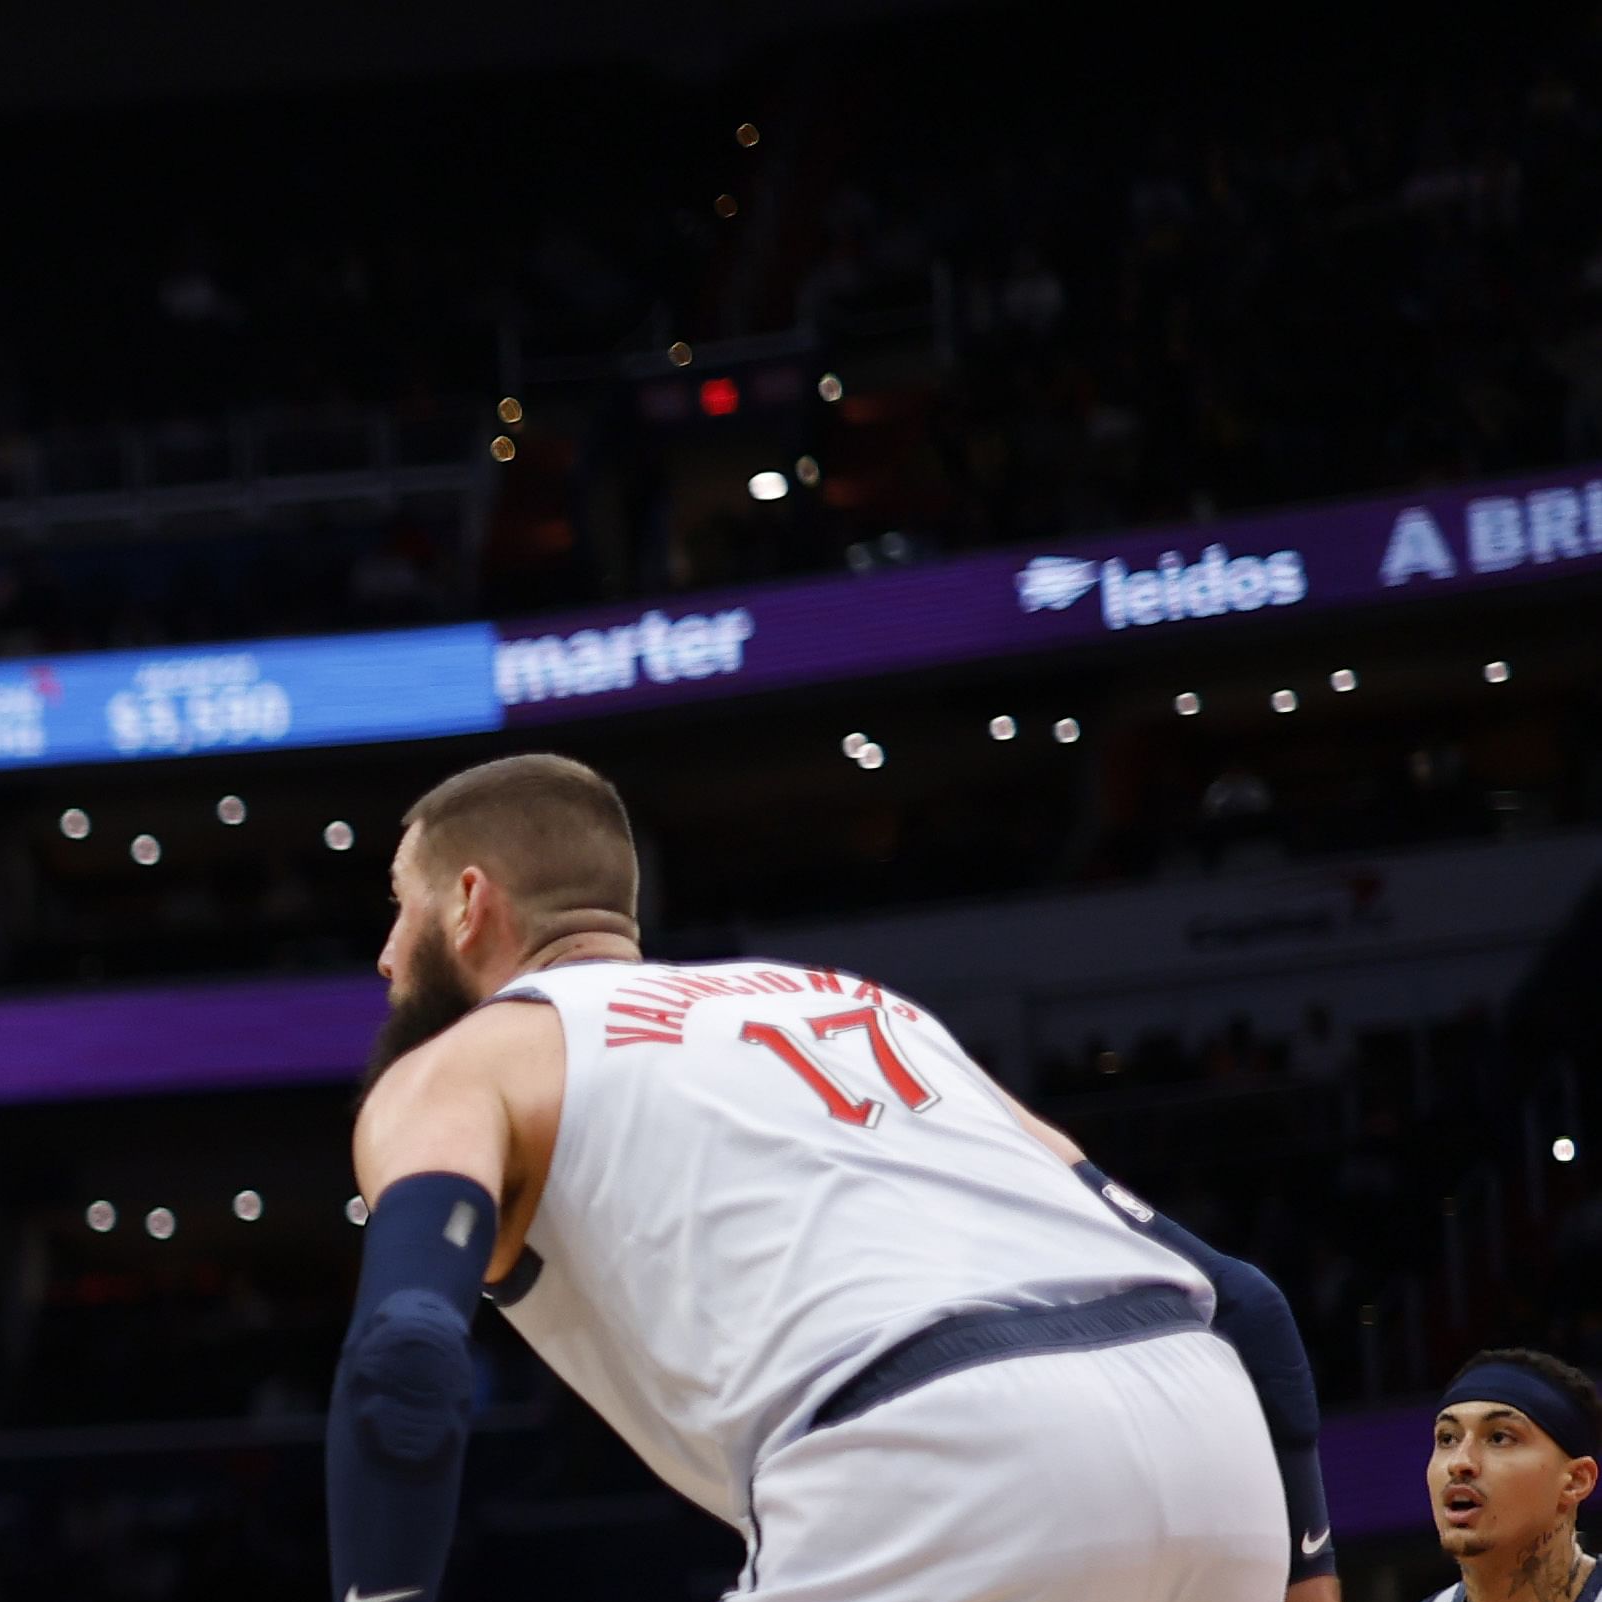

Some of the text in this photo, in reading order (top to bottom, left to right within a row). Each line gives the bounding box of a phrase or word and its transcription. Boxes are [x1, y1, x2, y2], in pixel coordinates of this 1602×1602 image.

[1101, 542, 1308, 631] leidos
[1379, 505, 1457, 588] A
[738, 1005, 941, 1130] 17
